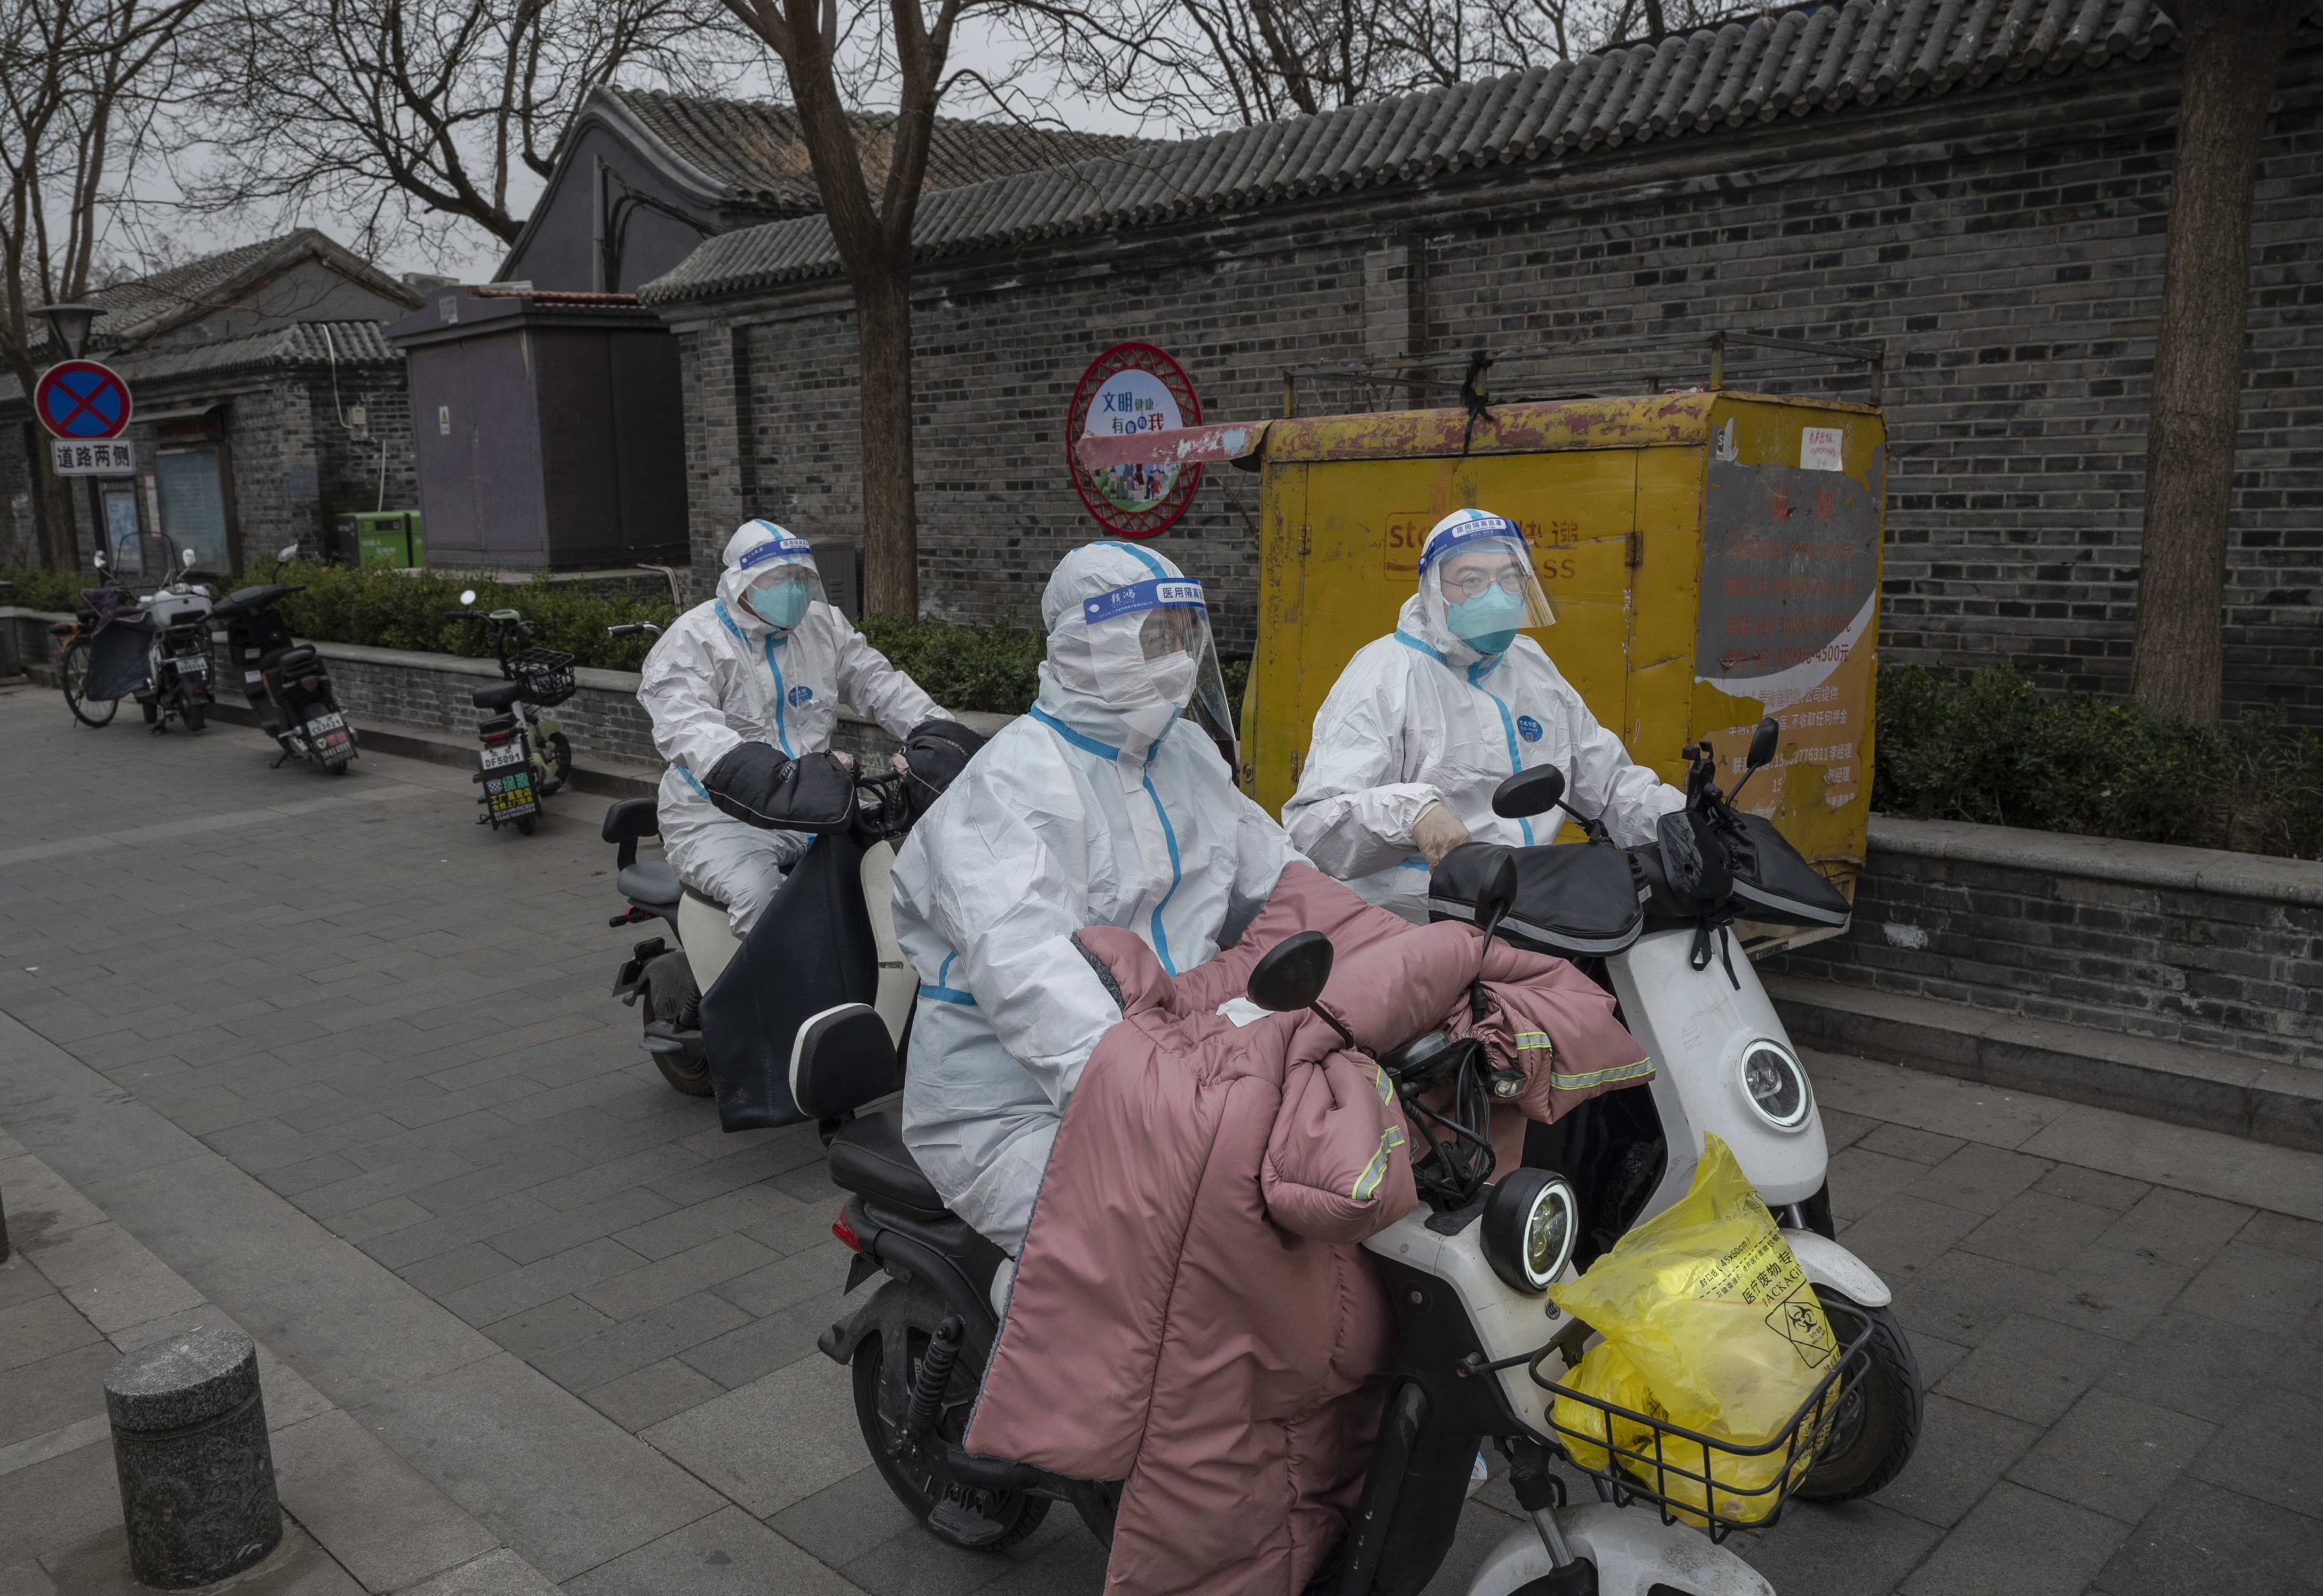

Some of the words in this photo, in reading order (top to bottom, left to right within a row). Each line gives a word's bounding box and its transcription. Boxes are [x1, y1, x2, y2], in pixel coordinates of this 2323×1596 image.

[1102, 391, 1153, 412] 文明健康
[57, 444, 129, 469] 道路两侧
[1456, 520, 1502, 533] 医用隔离面罩
[1726, 615, 1749, 636] 后勤
[1754, 616, 1771, 636] 5名
[1778, 614, 1851, 634] 3000元-4500元
[1777, 644, 1849, 665] 3000元-4500元
[485, 753, 521, 768] DF5091
[503, 772, 530, 792] 绿源
[1742, 1245, 1794, 1305] 医疗废物专
